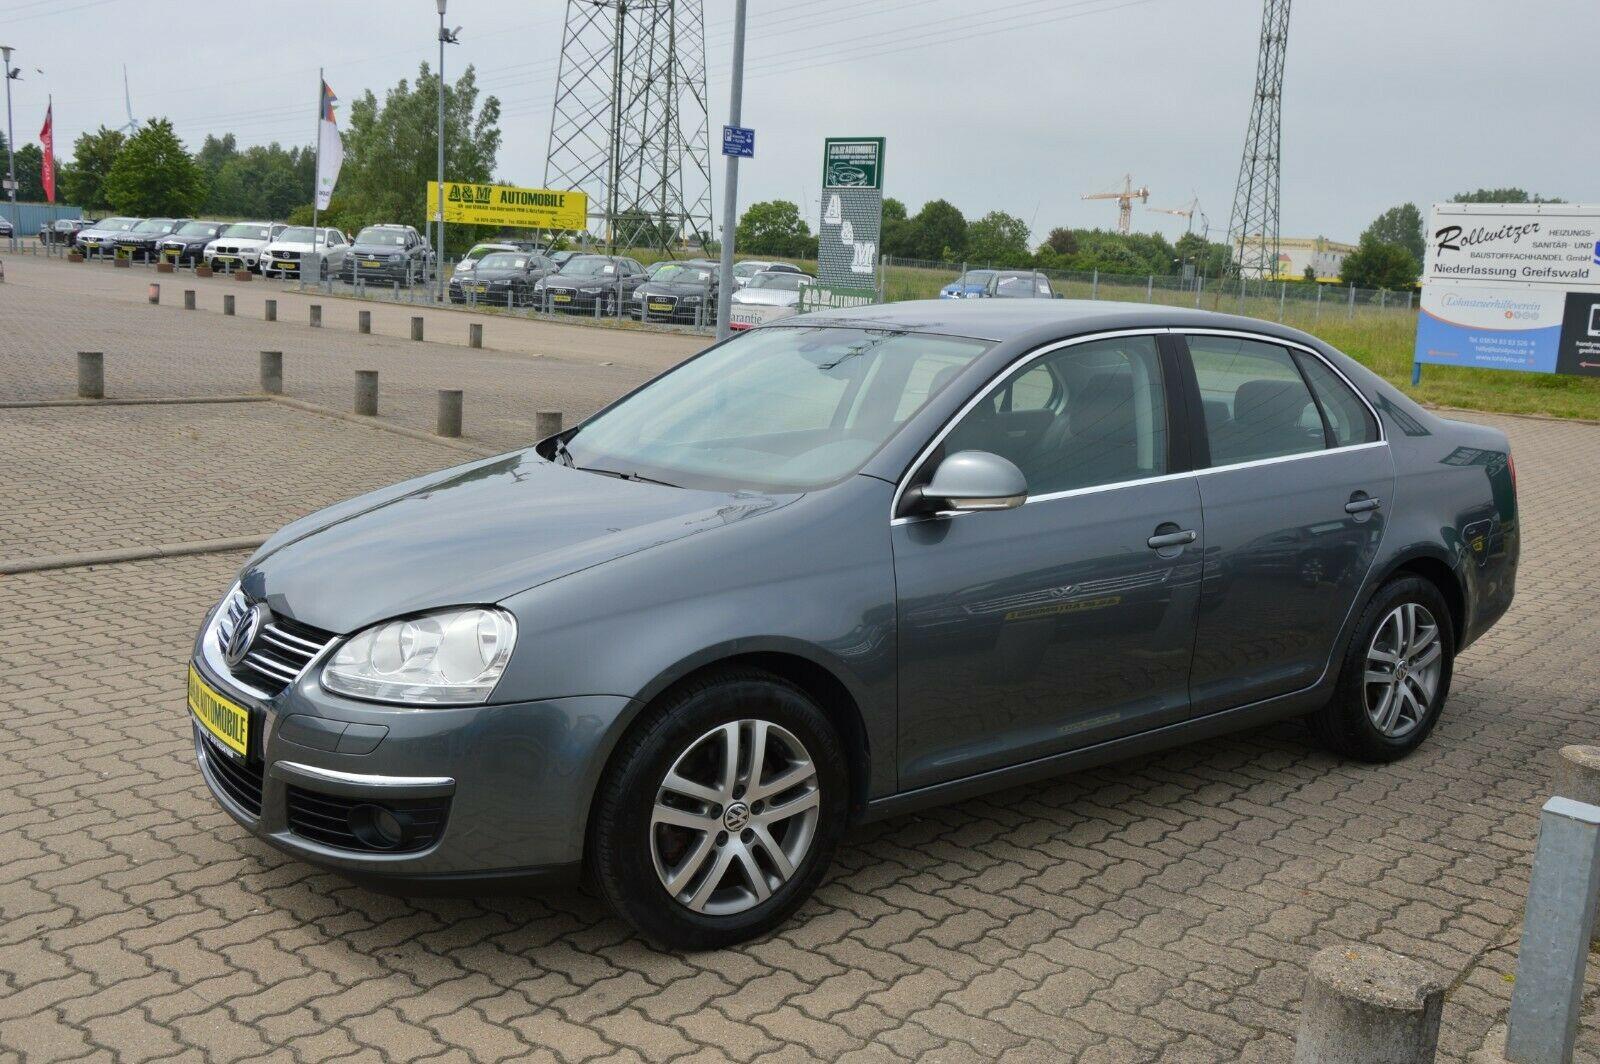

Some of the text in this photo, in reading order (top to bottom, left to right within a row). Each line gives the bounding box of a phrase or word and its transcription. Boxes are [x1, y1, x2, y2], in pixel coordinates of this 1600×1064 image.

[500, 190, 565, 207] AUTOMOBILE
[1435, 223, 1540, 257] Rollwitzer
[1549, 229, 1595, 237] HEIZUNGS-
[1566, 254, 1592, 262] GmbH
[1434, 263, 1590, 279] Niederlassung Greifswald
[730, 313, 762, 325] arantie
[201, 685, 246, 746] AUTOMOBILE
